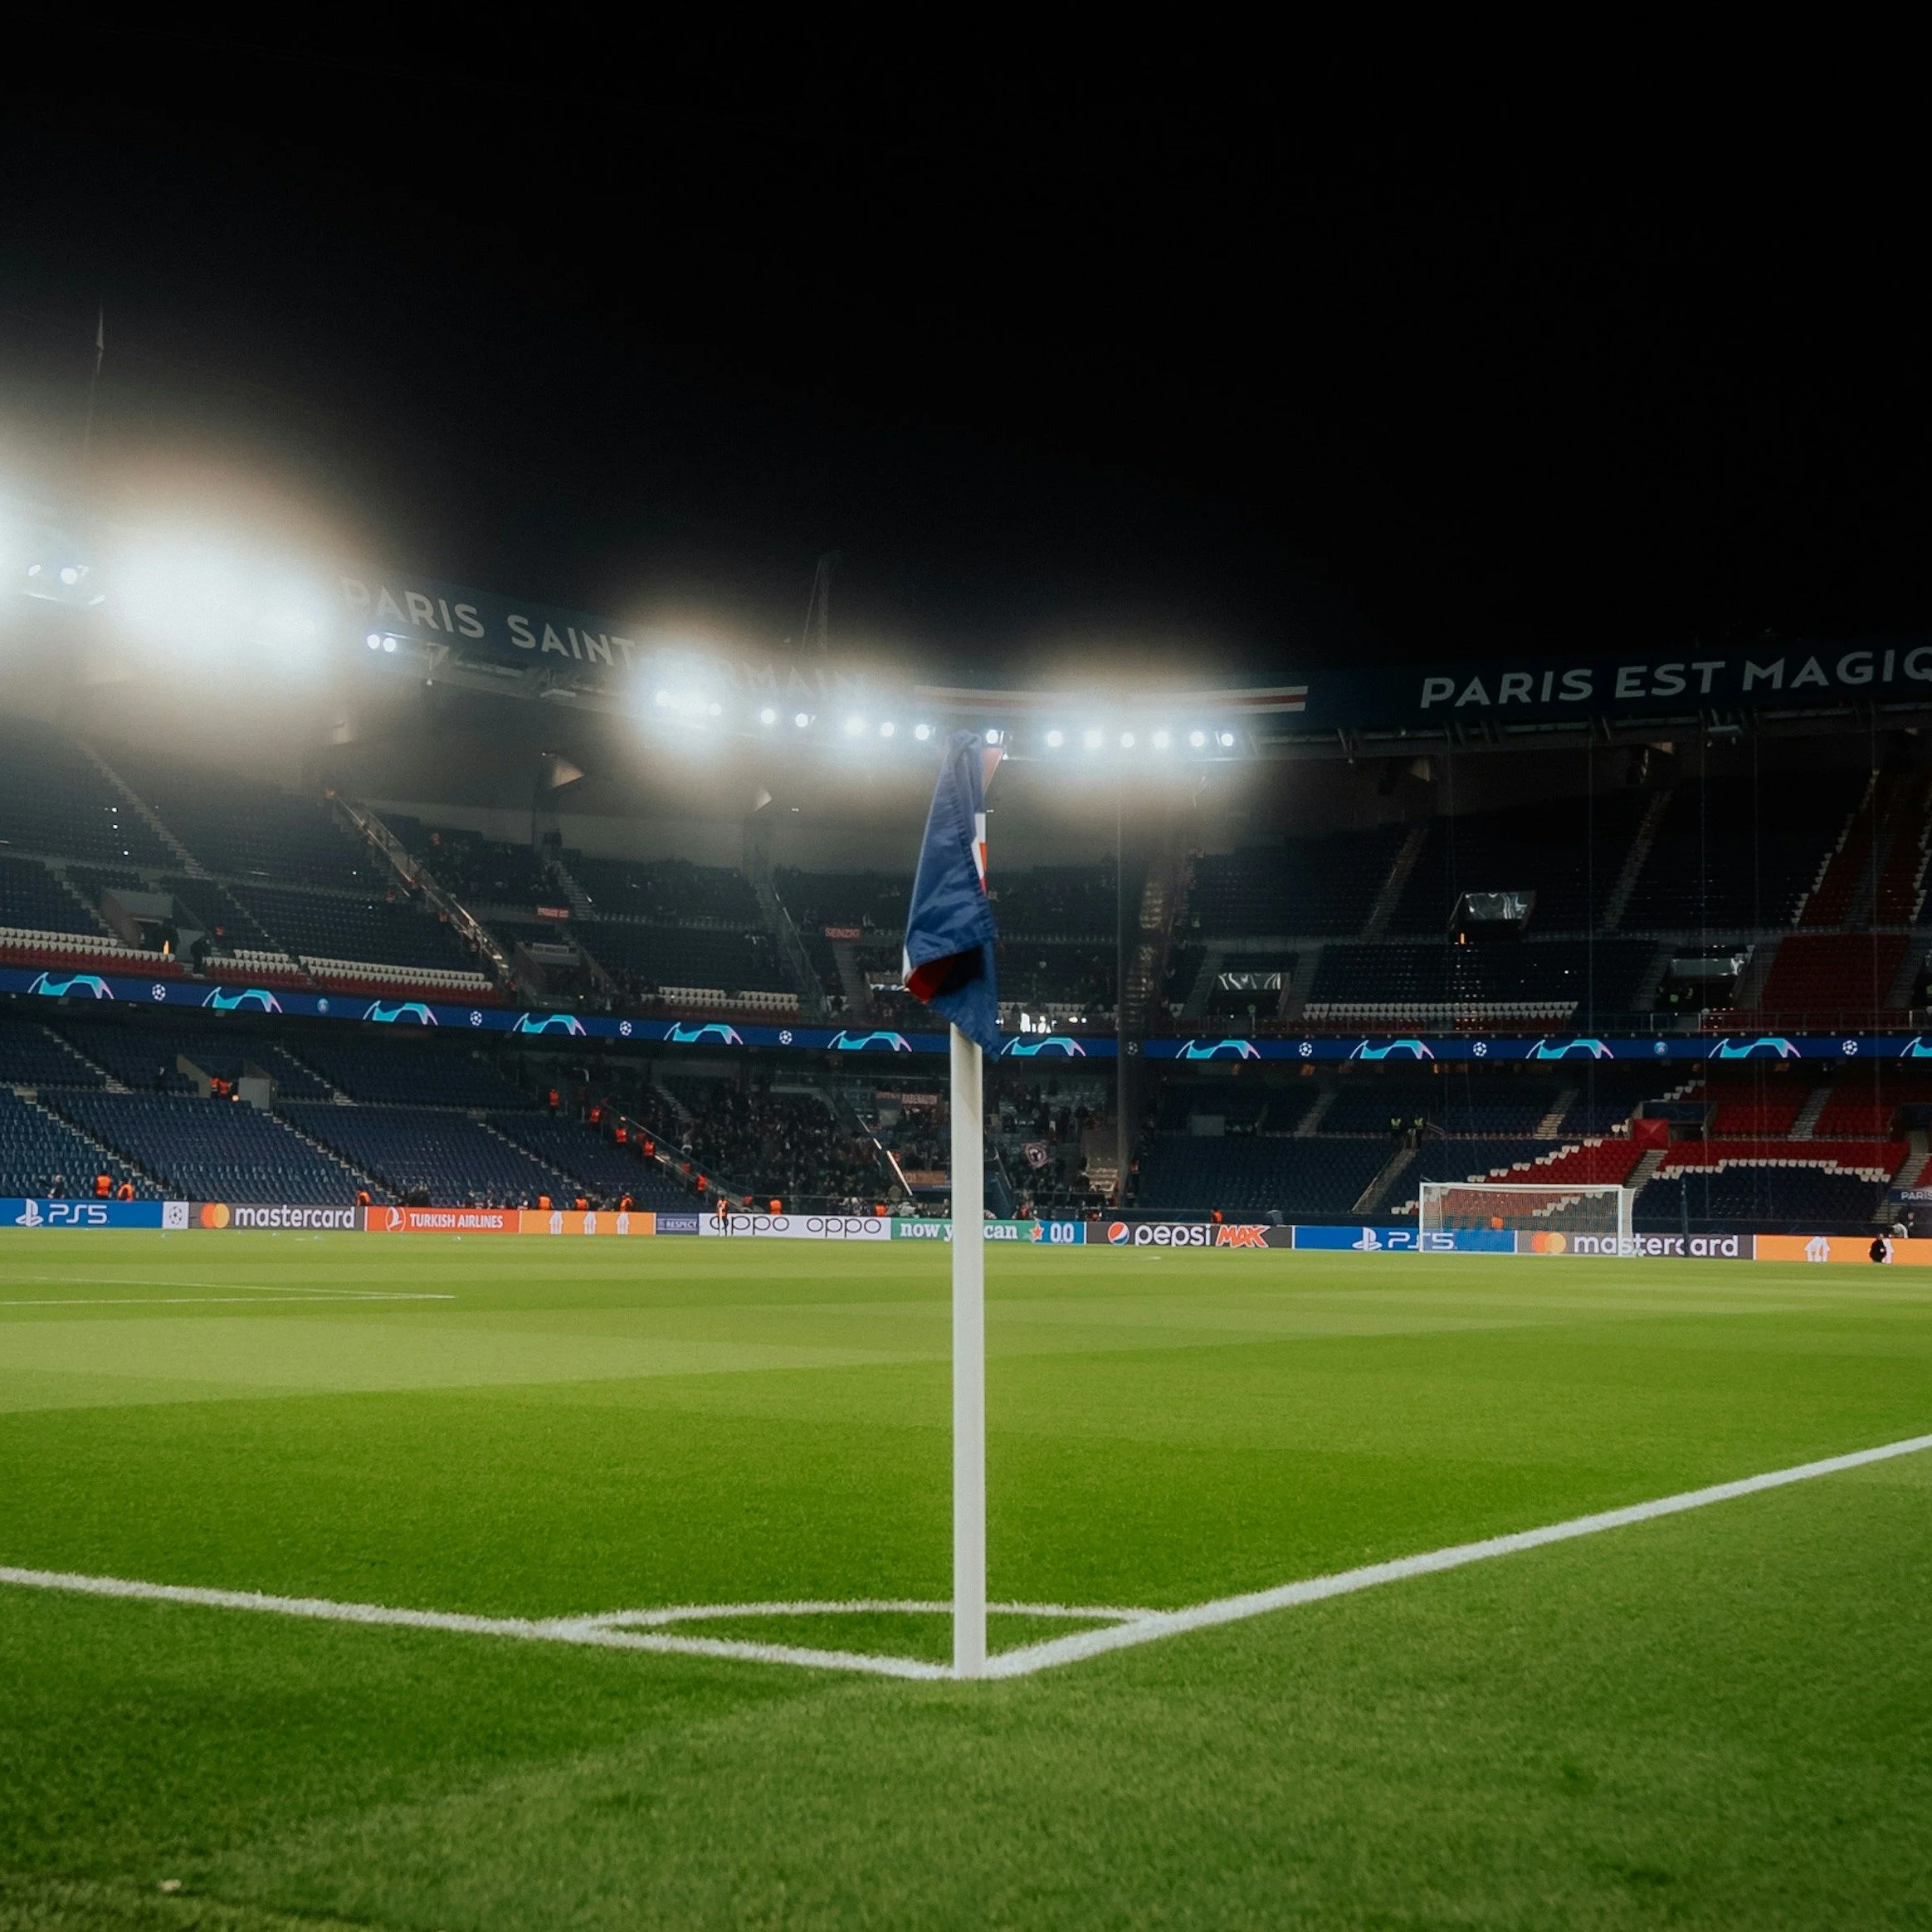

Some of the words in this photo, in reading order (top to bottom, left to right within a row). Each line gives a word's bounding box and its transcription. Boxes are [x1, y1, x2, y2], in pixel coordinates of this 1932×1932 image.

[506, 613, 636, 666] SAINT
[1420, 668, 1593, 709] PARIS
[1614, 661, 1726, 700] EST
[1742, 646, 1932, 691] MAGIQ
[48, 1203, 108, 1225] PS5
[234, 1204, 356, 1229] mastercard
[410, 1212, 456, 1228] TURKISH
[457, 1214, 504, 1229] AIRLINES
[666, 1220, 697, 1228] RESPECT
[710, 1215, 789, 1236] oppo
[807, 1217, 882, 1238] oppo
[900, 1223, 940, 1237] now
[984, 1224, 1018, 1239] can
[1134, 1223, 1212, 1247] pepsi
[1215, 1224, 1273, 1248] MAX
[1388, 1231, 1455, 1250] PS5
